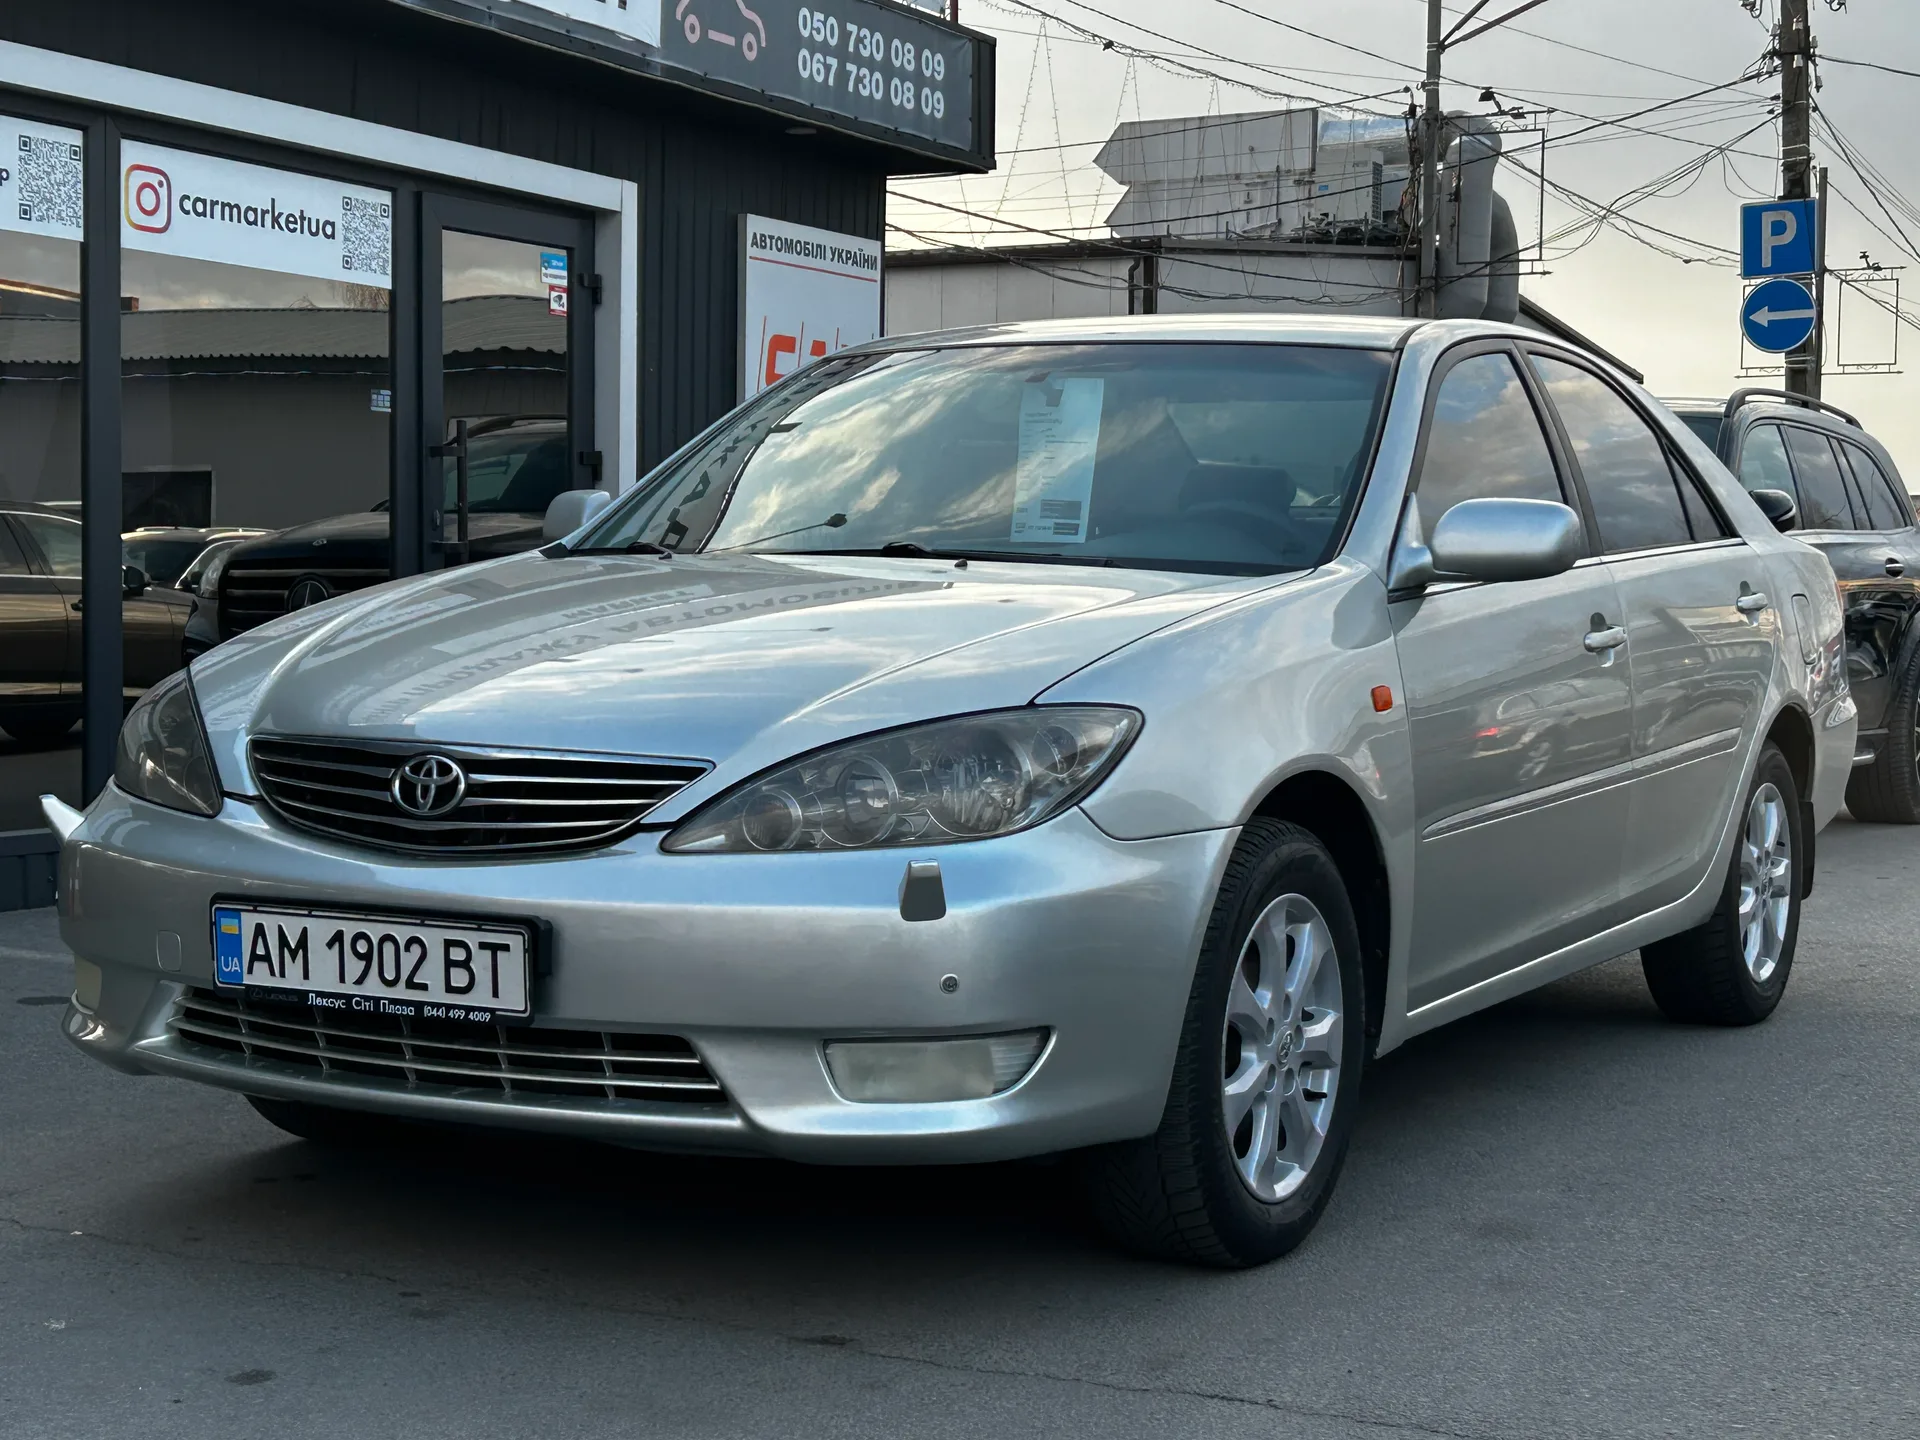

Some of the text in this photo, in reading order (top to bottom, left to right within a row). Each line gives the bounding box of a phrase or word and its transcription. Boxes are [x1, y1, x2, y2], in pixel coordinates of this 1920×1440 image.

[798, 7, 945, 81] 050 730 08 09
[798, 48, 944, 119] 067 730 08 09
[178, 193, 337, 241] carmarketua
[1761, 210, 1797, 268] P
[750, 231, 878, 271] АВТОМОБІЛІ УКРАЇНИ
[221, 956, 242, 974] UA
[246, 922, 511, 999] AM 1902 BT
[307, 993, 491, 1023] Лексус Сіті Плаза (044) 499 4009
